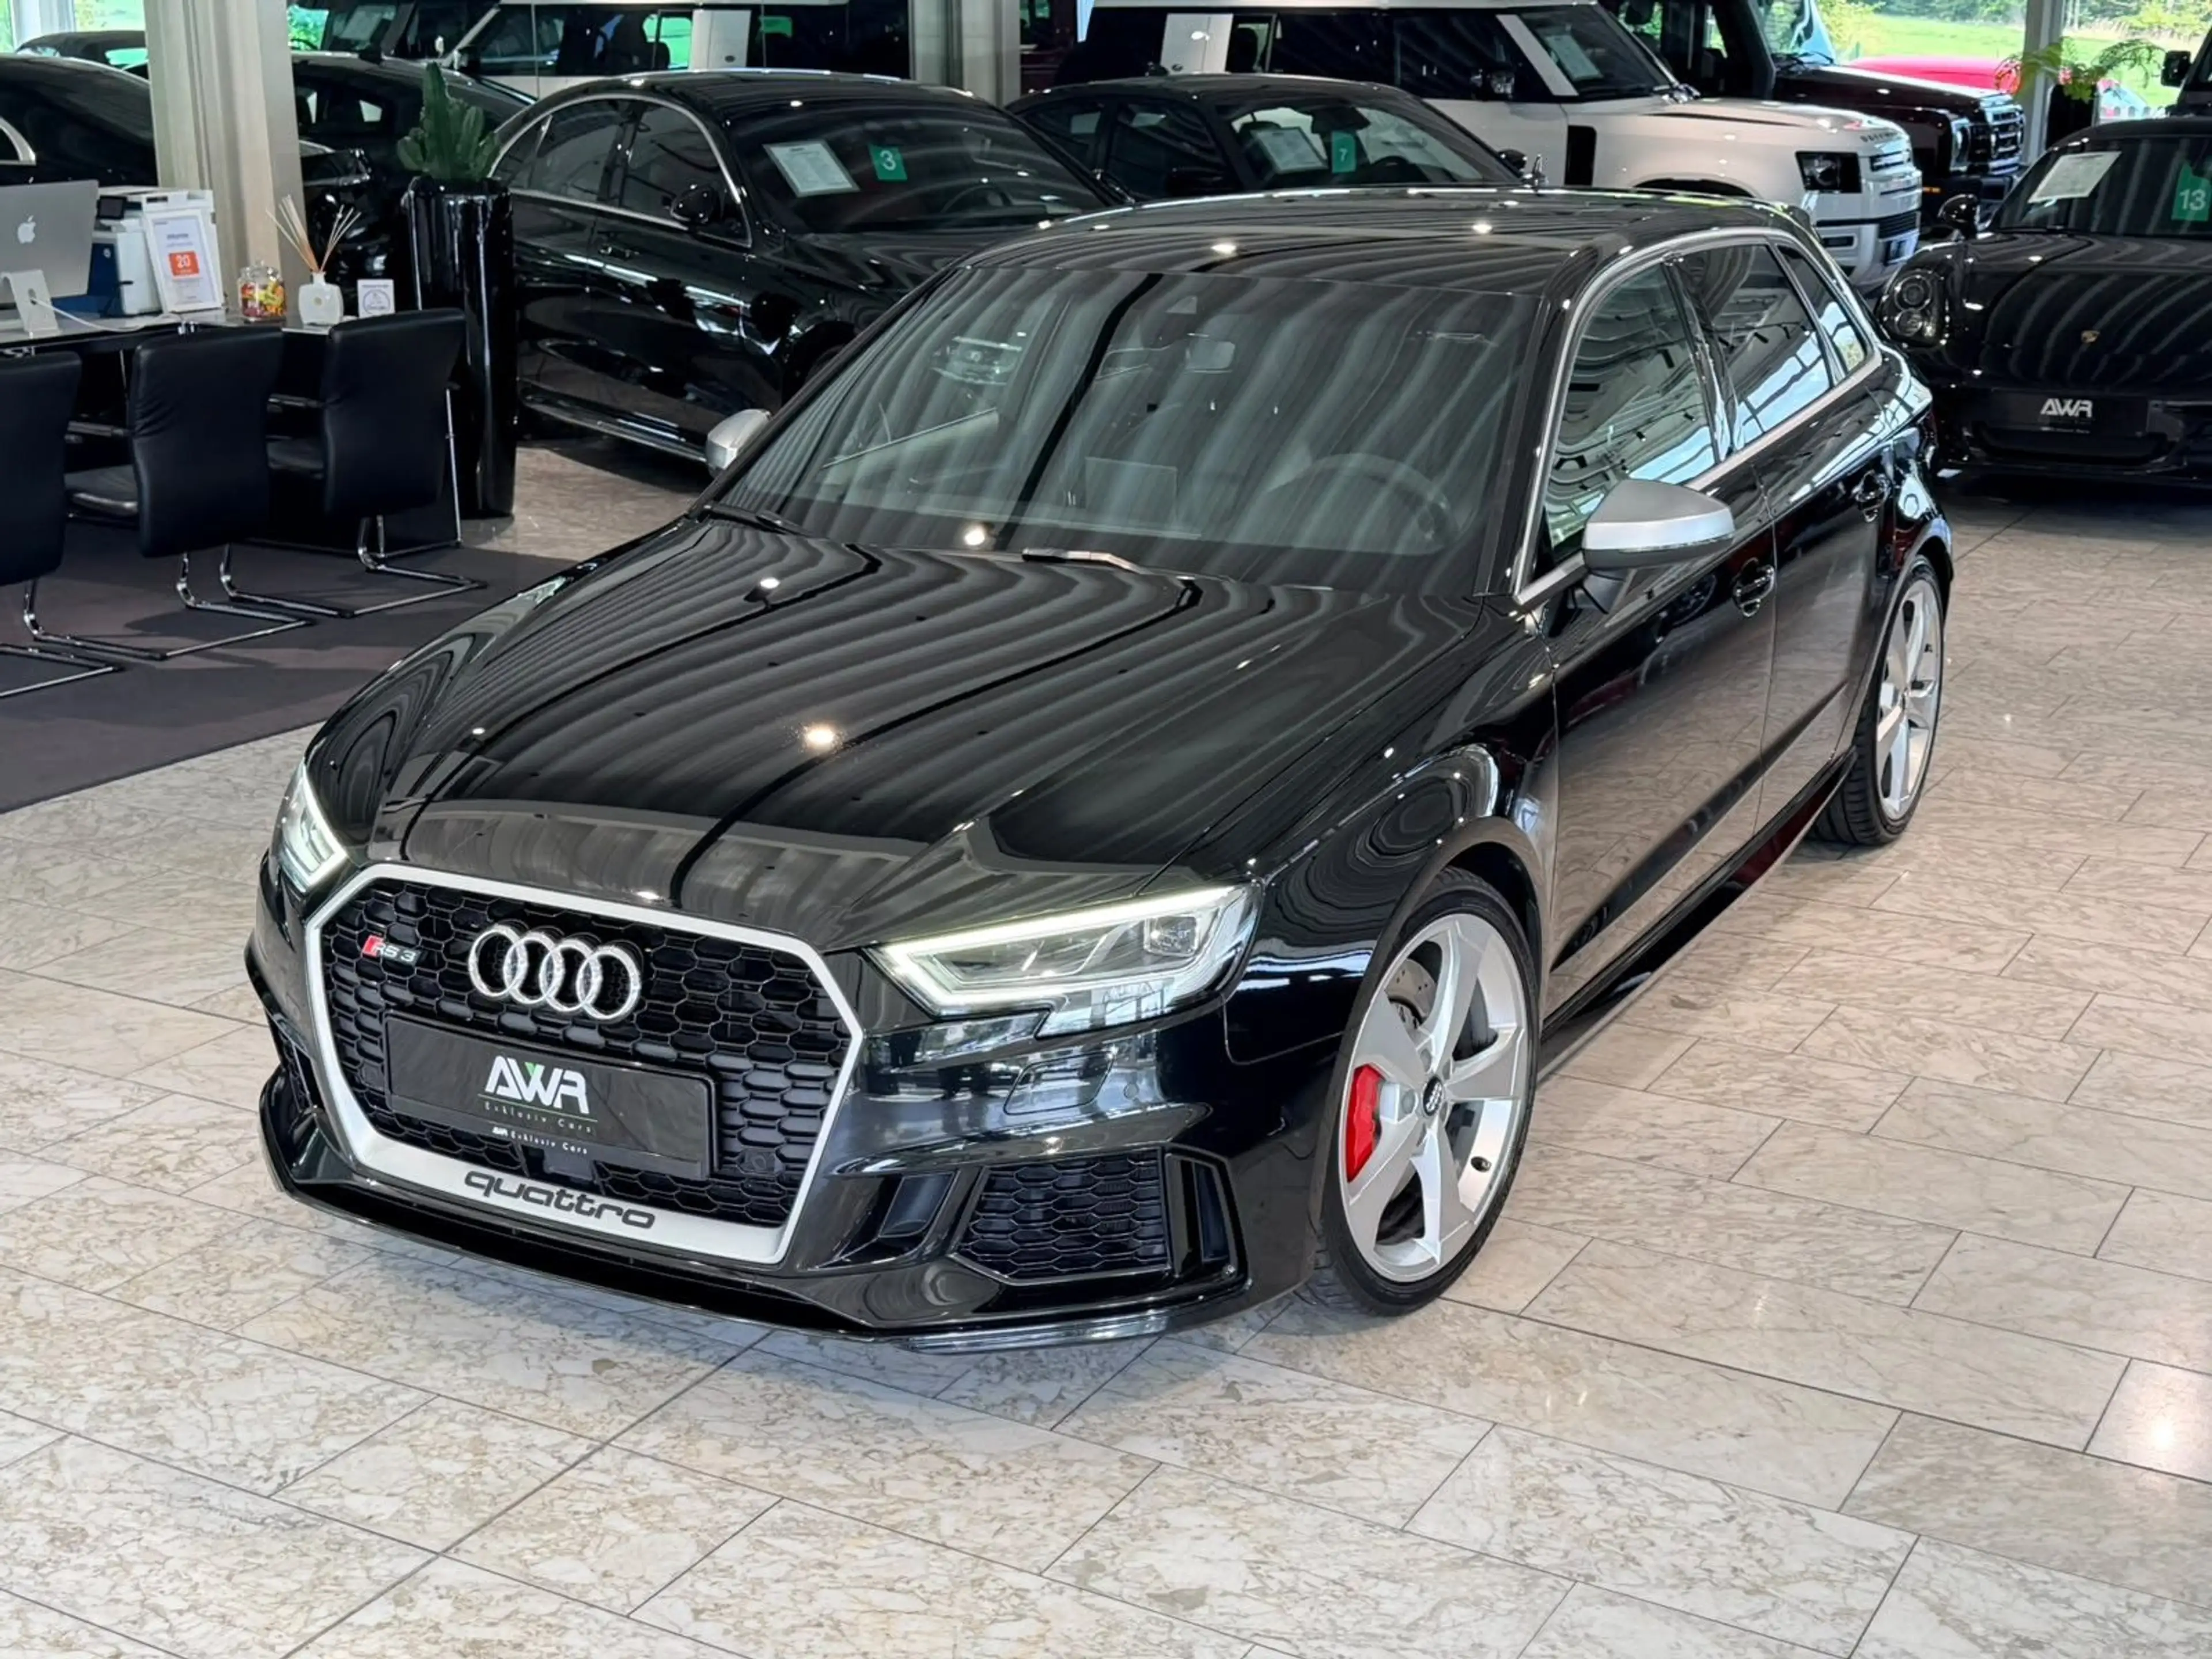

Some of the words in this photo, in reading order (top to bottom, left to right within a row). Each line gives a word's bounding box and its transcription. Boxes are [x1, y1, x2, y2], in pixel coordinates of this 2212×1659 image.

[880, 149, 897, 171] 3
[1339, 148, 1349, 162] 7
[2179, 189, 2206, 211] 13
[2040, 397, 2093, 418] AWR
[484, 1055, 590, 1115] AWR
[558, 1118, 592, 1133] Cars
[562, 1142, 588, 1155] Cars
[464, 1171, 656, 1229] quattro
